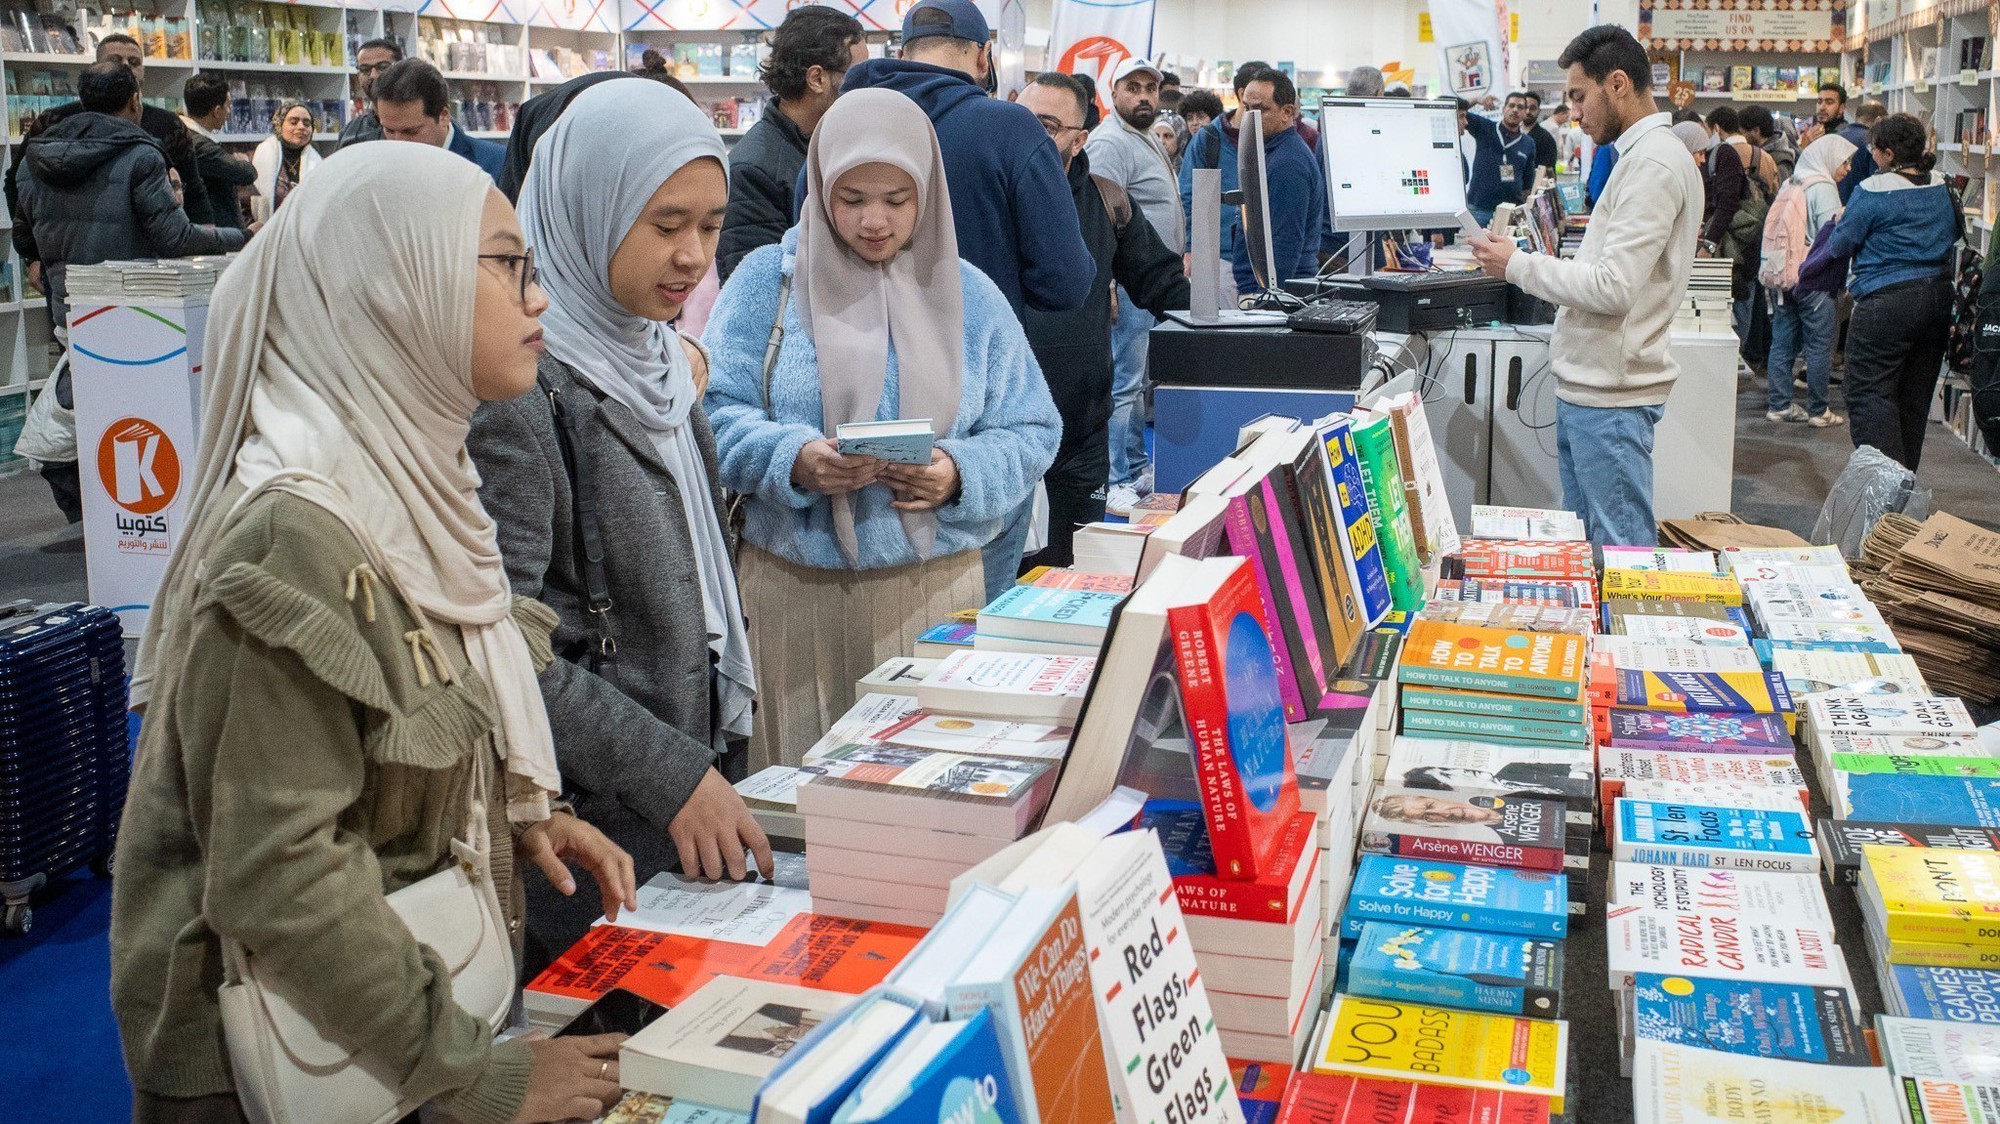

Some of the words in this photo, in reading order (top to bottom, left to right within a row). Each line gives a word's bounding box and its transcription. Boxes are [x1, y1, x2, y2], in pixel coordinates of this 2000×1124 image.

[1725, 26, 1738, 34] US
[1741, 26, 1754, 34] ON
[1730, 14, 1752, 22] FIND
[1983, 324, 2000, 332] JAC
[1359, 461, 1374, 487] LET
[1367, 488, 1382, 528] THEM
[115, 512, 167, 538] كتوبيا
[1352, 520, 1374, 556] ADHD
[1607, 592, 1639, 601] What's
[1641, 593, 1662, 602] Your
[1664, 594, 1700, 603] Dream?
[1179, 631, 1199, 688] GREENE
[1193, 630, 1211, 685] ROBERT
[1430, 640, 1453, 665] HOW
[1455, 652, 1474, 666] TO
[1479, 646, 1501, 669] TALK
[1504, 657, 1524, 671] TO
[1529, 635, 1553, 675] ANYONE
[1563, 640, 1578, 665] LOWNDES
[1039, 657, 1078, 679] SAYING
[1561, 665, 1574, 677] LEIL
[1028, 682, 1058, 691] NO
[1406, 671, 1425, 680] HOW
[1427, 673, 1438, 681] TO
[1440, 674, 1459, 684] TALK
[1462, 676, 1472, 685] TO
[1474, 678, 1508, 688] ANYONE
[1528, 684, 1556, 692] LOWNDES
[1410, 697, 1429, 705] HOW
[1431, 698, 1443, 706] TO
[1445, 699, 1463, 708] TALK
[1466, 701, 1476, 709] TO
[1478, 702, 1512, 712] ANYONE
[1825, 699, 1850, 728] THINK
[1848, 698, 1872, 728] AGAIN
[1916, 701, 1933, 725] ADAM
[1927, 700, 1953, 728] GRANT
[1412, 717, 1431, 725] HOW
[1433, 718, 1444, 726] TO
[1446, 720, 1465, 729] TALK
[1467, 721, 1478, 729] TO
[1480, 722, 1514, 732] ANYONE
[1534, 727, 1562, 735] LOWNDES
[1212, 728, 1225, 756] THE
[1195, 719, 1213, 771] HUMAN
[1207, 775, 1225, 832] NATURE
[1218, 761, 1234, 796] LAWS
[1602, 767, 1616, 778] The
[1620, 752, 1635, 779] Greatness
[1636, 759, 1653, 781] Mindset
[1226, 801, 1237, 820] OF
[1499, 804, 1520, 836] Arsène
[1517, 802, 1542, 843] WENGER
[1695, 811, 1723, 843] Focus
[1412, 838, 1459, 854] Arsène
[1461, 842, 1523, 860] WENGER
[1631, 849, 1677, 866] JOHANN
[1682, 852, 1710, 867] HARI
[1715, 857, 1726, 866] ST
[1734, 858, 1754, 868] LEN
[1757, 860, 1792, 871] FOCUS
[1176, 885, 1204, 896] AWS
[1210, 888, 1227, 897] OF
[1379, 864, 1419, 899] Solve
[1414, 879, 1450, 902] for
[1452, 866, 1497, 905] Happy
[1631, 881, 1644, 896] THE
[1652, 866, 1668, 910] SYCHOLOGY
[1673, 868, 1691, 903] STUPIDITY
[712, 895, 775, 935] Thinking
[1181, 899, 1237, 912] NATURE
[1358, 901, 1392, 914] Solve
[1394, 904, 1411, 916] for
[1413, 907, 1453, 922] Happy
[1678, 903, 1691, 912] F
[751, 912, 786, 935] Over
[1979, 929, 2000, 938] DON
[1123, 917, 1164, 985] Red
[1677, 915, 1708, 968] RADICAL
[1710, 917, 1745, 971] CANDOR
[1796, 928, 1823, 951] SCOTT
[1019, 966, 1041, 1003] We
[1038, 940, 1063, 978] Can
[1059, 916, 1078, 944] Do
[1802, 953, 1828, 969] KIM
[1980, 953, 2000, 962] DON
[1023, 991, 1054, 1048] Hard
[1051, 946, 1087, 1011] Things
[1131, 972, 1189, 1044] Flags,
[1703, 993, 1721, 1021] Things
[1929, 968, 1976, 1022] GAMES
[1959, 969, 2000, 1023] PEOPLE
[1824, 1001, 1838, 1026] SUNIM
[1343, 1000, 1403, 1063] YOU
[1411, 1010, 1450, 1073] BADASS
[1706, 1022, 1720, 1039] The
[1831, 1027, 1845, 1053] HAEMIN
[1146, 1014, 1202, 1095] Green
[1164, 1067, 1213, 1124] Flags
[1724, 1083, 1745, 1118] BODY
[1750, 1079, 1765, 1096] NO
